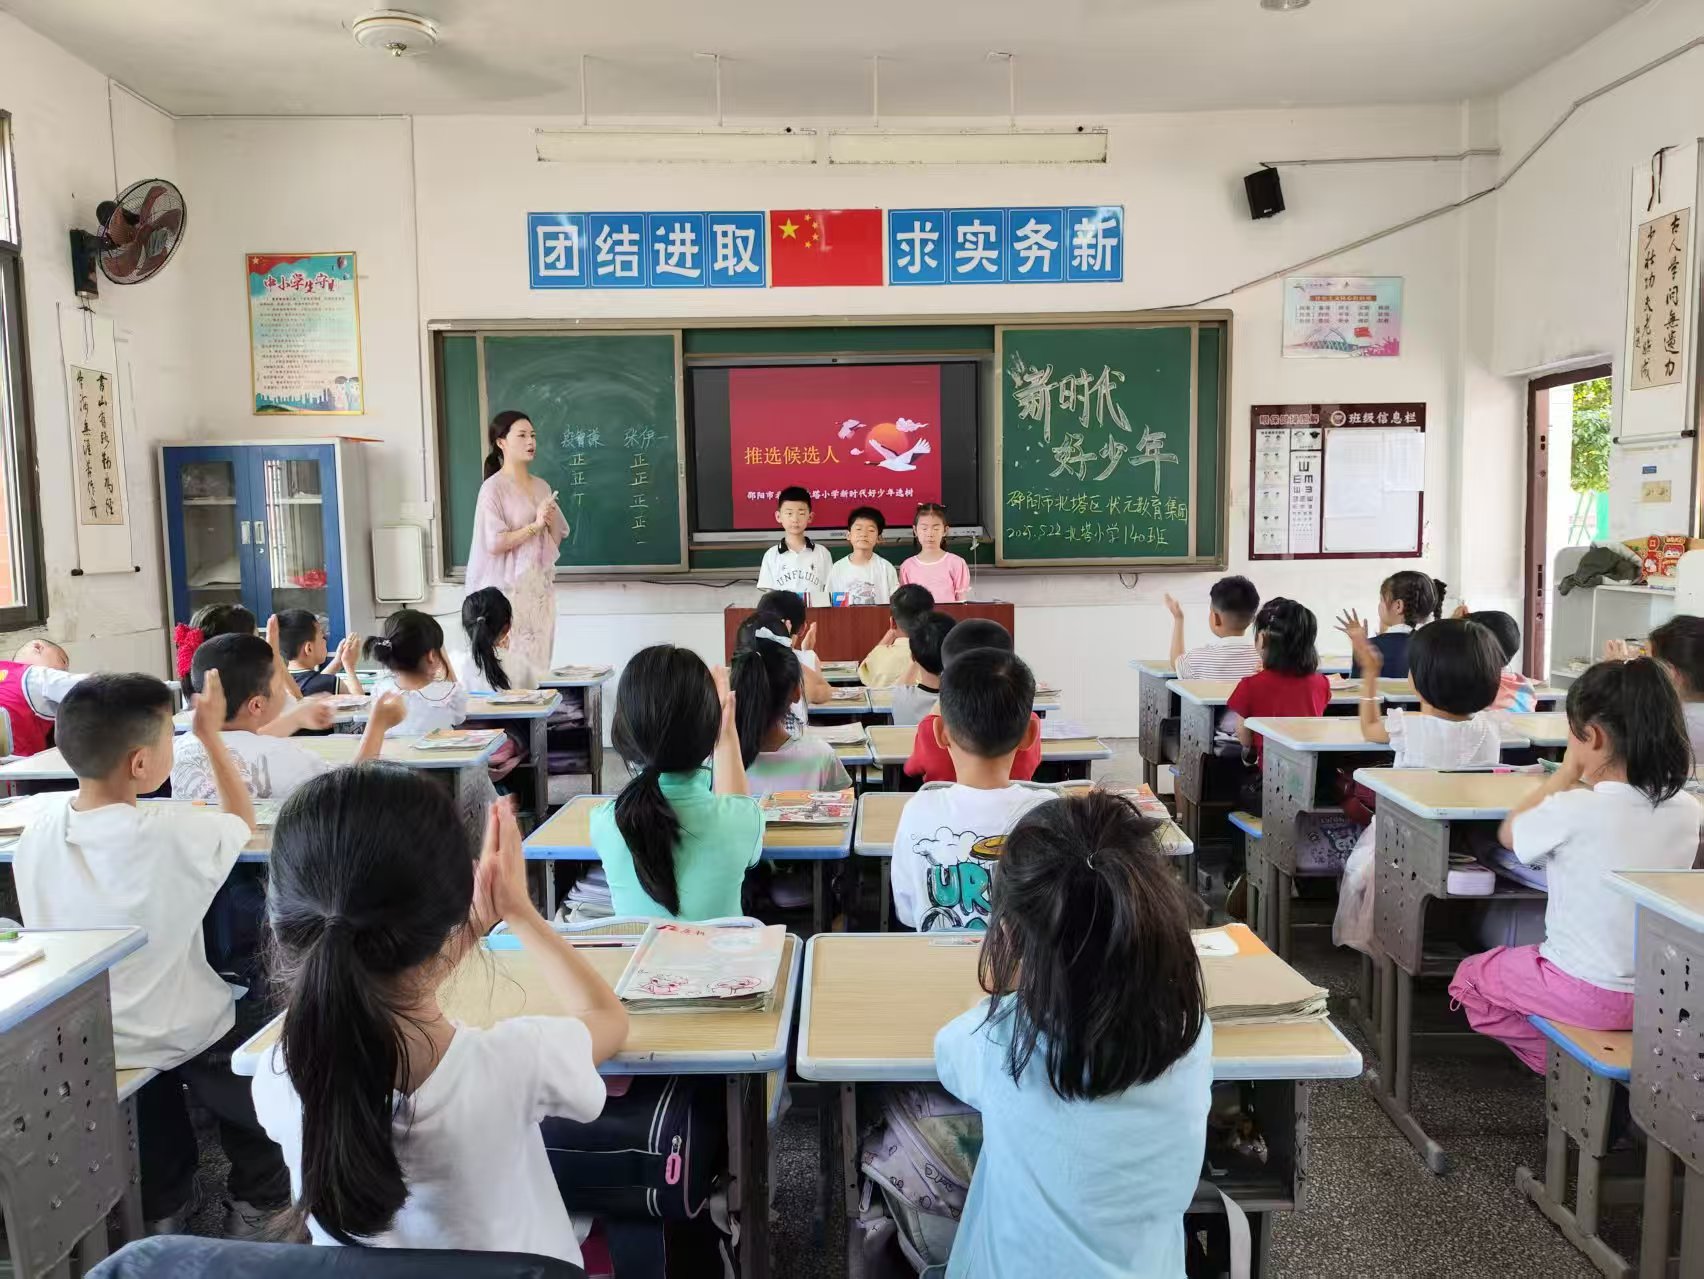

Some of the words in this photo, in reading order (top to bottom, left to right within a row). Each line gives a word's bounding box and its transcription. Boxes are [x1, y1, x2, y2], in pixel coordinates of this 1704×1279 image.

[536, 222, 760, 278] 团结进取
[896, 217, 1118, 274] 求实务新
[1012, 363, 1133, 444] 新时代
[1348, 410, 1417, 425] 班级信息栏
[744, 445, 840, 465] 推选候选人
[1049, 423, 1180, 495] 好少年
